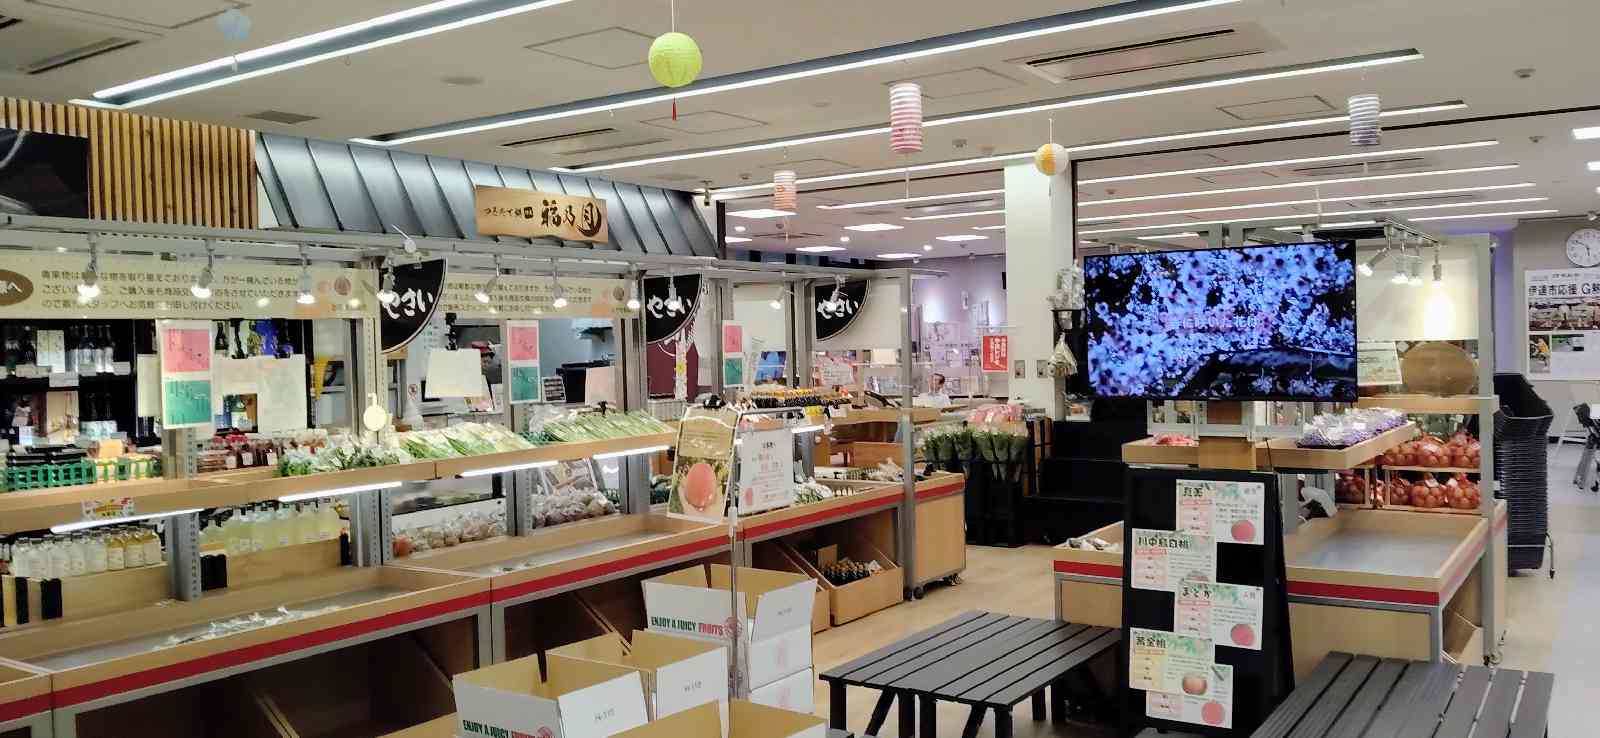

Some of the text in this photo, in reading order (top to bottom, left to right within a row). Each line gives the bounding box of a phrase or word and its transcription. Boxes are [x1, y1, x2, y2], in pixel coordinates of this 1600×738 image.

[650, 616, 671, 628] ENJOY
[676, 620, 697, 632] JUICY
[697, 622, 723, 636] FRUITS
[462, 719, 483, 735] ENJOY
